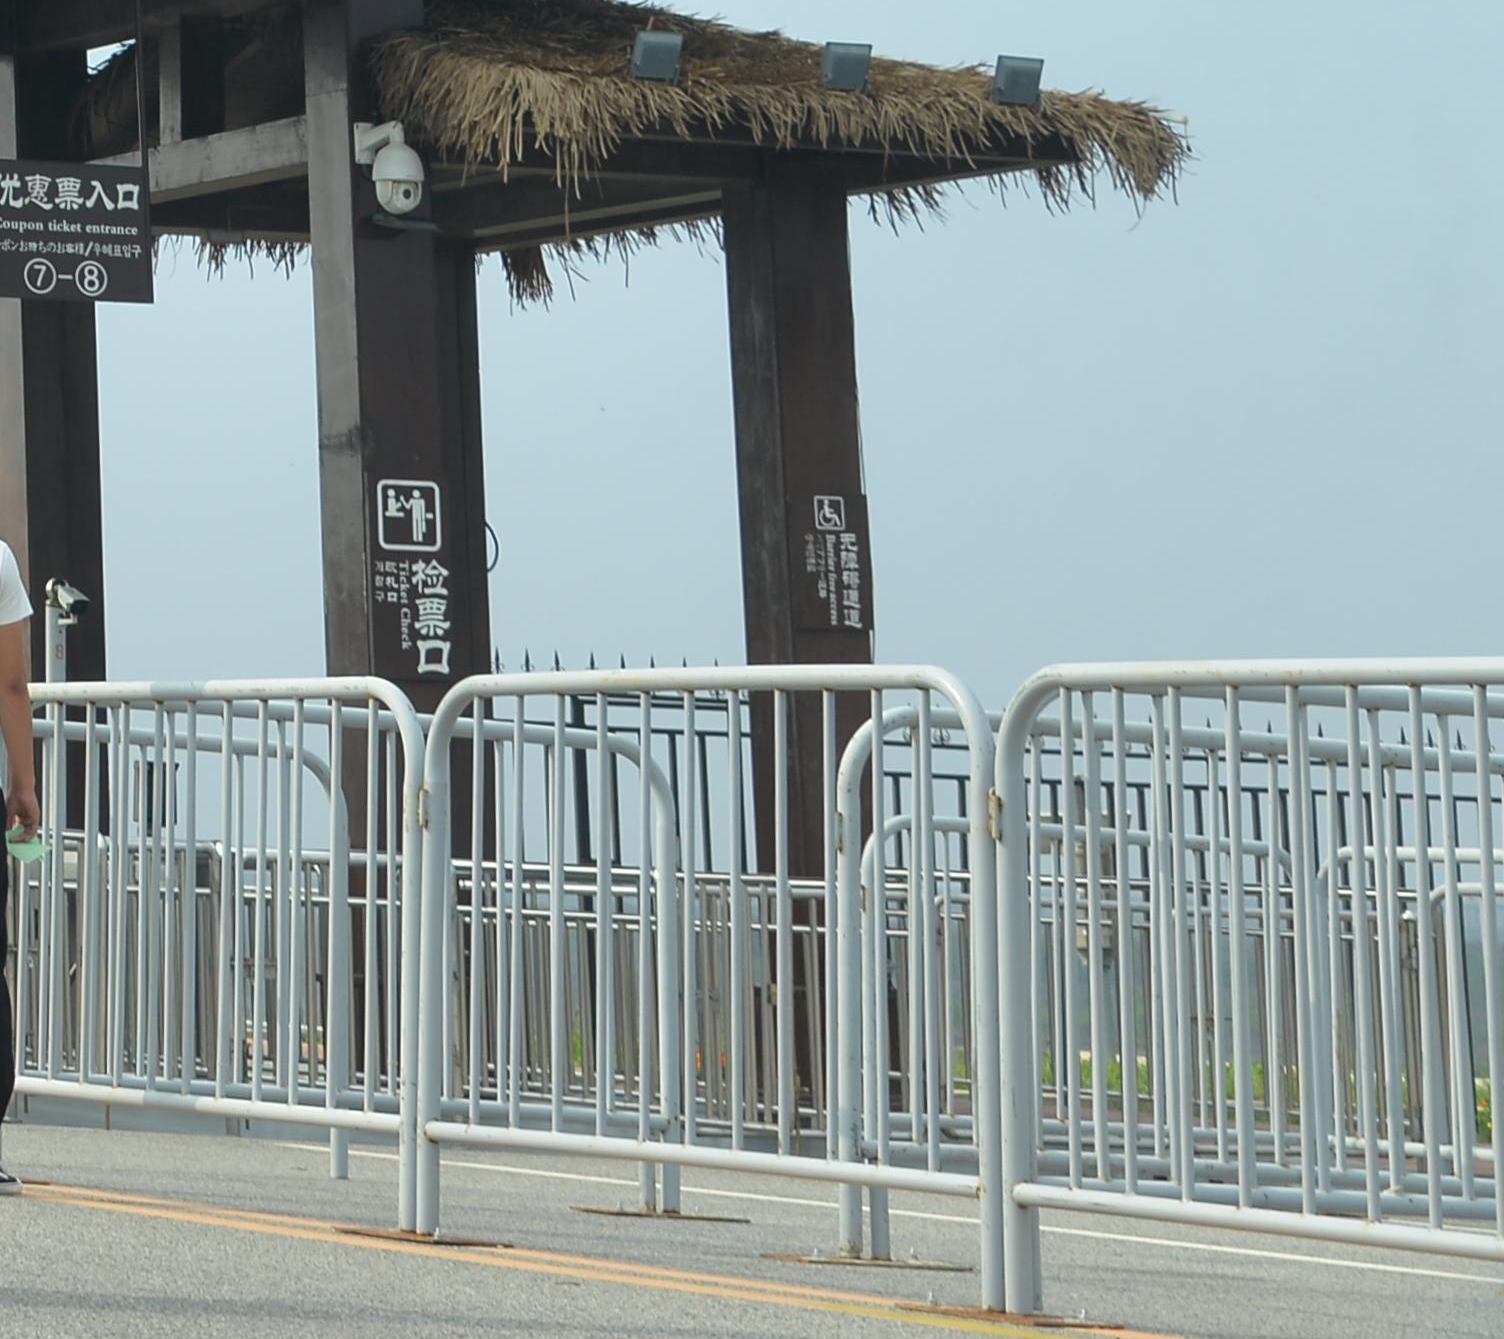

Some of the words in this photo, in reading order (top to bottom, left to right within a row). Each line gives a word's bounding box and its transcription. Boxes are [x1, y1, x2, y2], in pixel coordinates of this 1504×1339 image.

[48, 219, 82, 233] ticket
[85, 222, 139, 236] entrance
[399, 560, 411, 604] Ticket
[400, 607, 413, 651] Check
[411, 559, 451, 675] 检票口
[55, 644, 65, 660] 8
